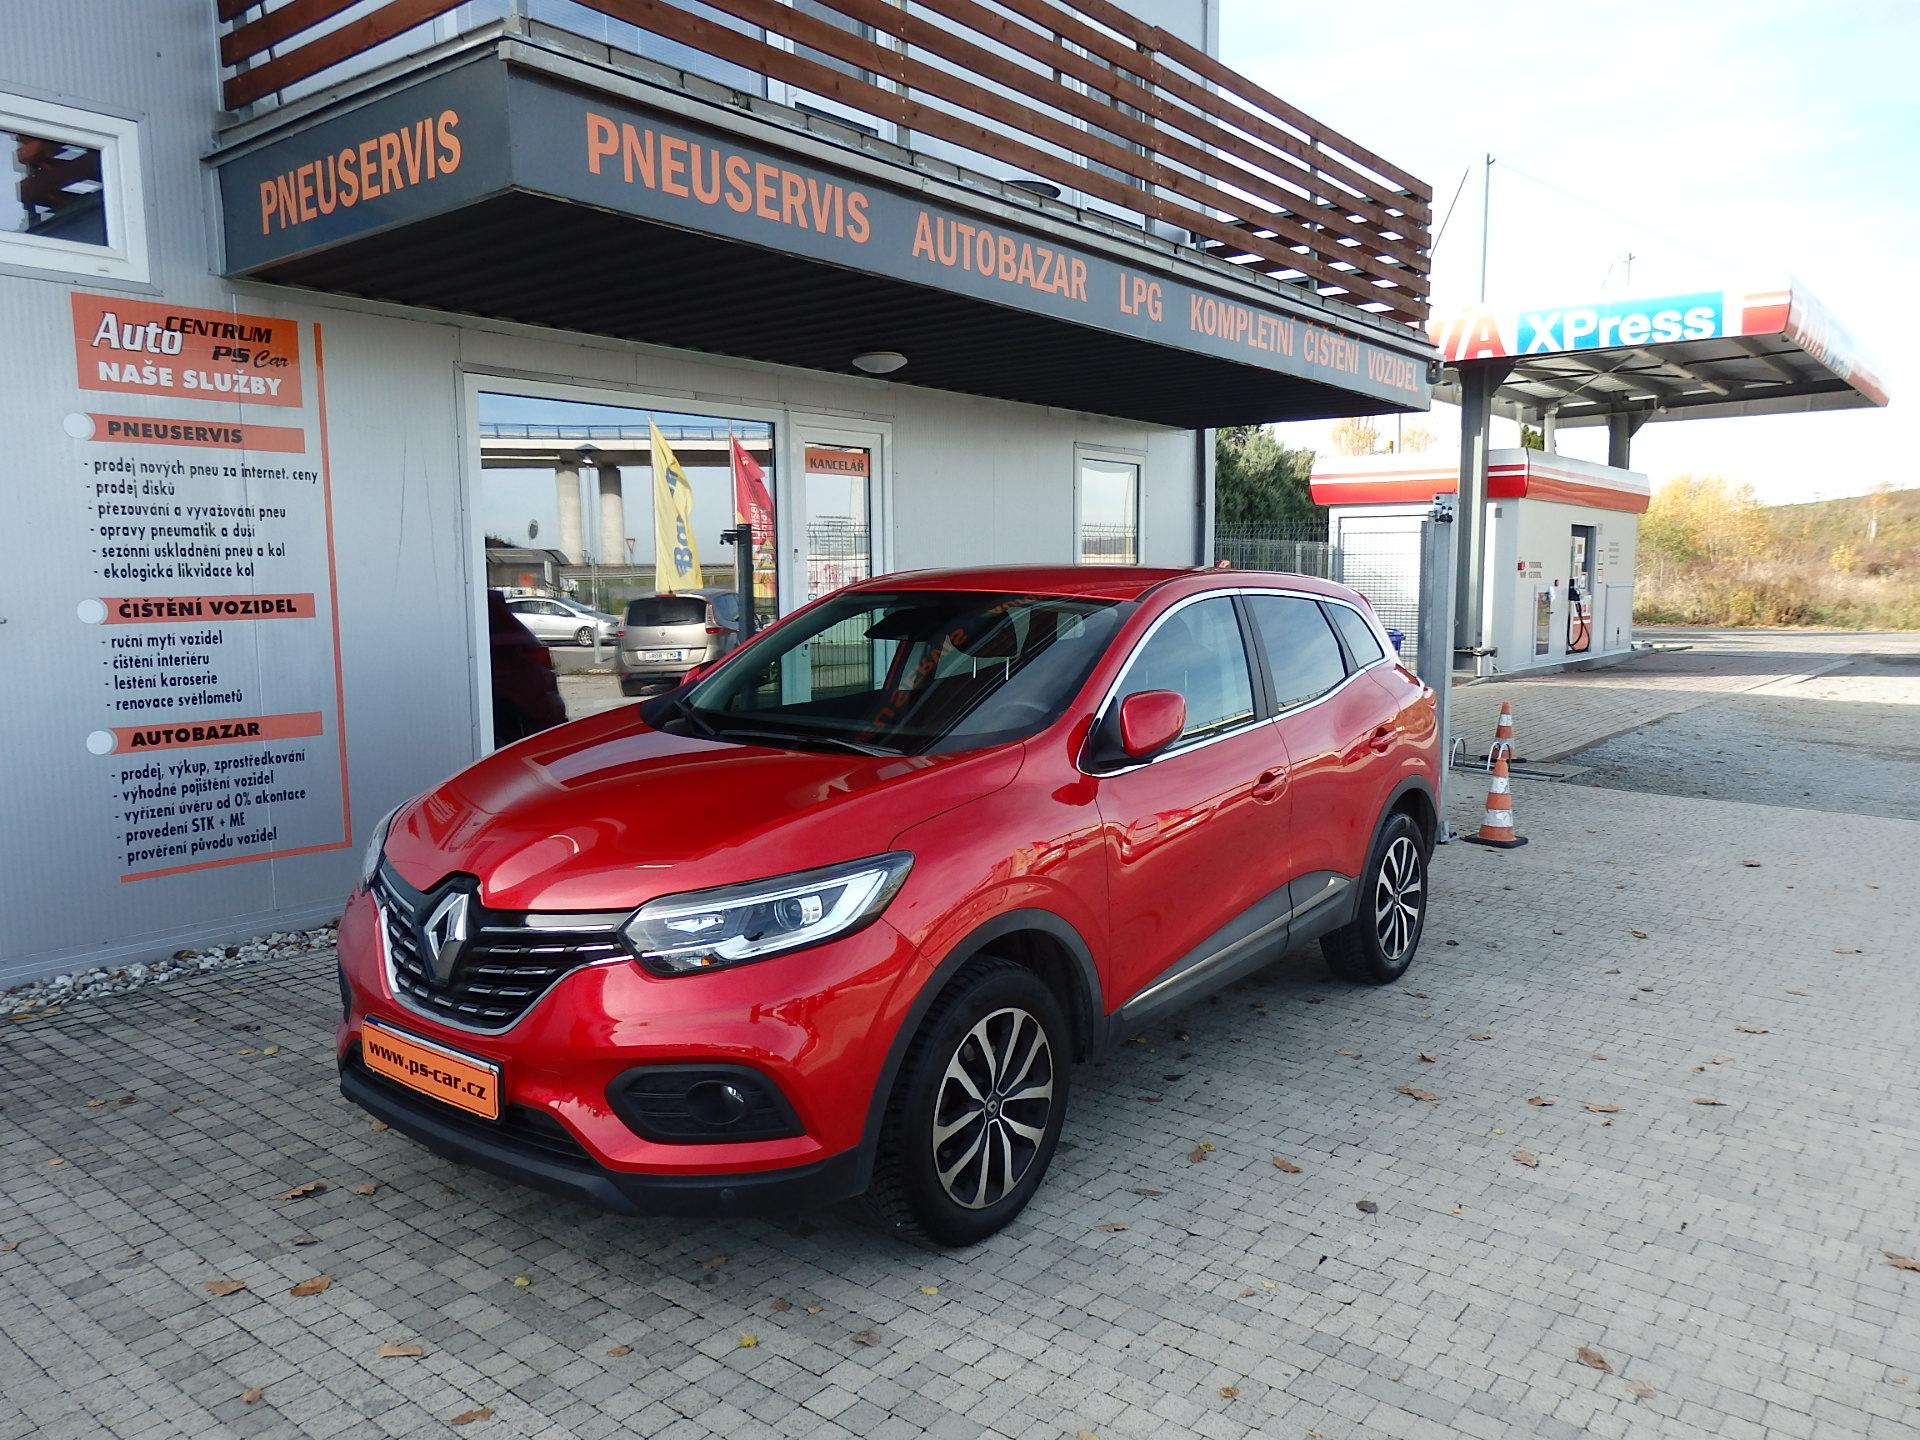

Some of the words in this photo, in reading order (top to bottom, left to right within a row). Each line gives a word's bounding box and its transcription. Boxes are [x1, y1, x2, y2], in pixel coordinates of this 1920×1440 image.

[260, 110, 462, 235] PNEUSERVIS
[585, 111, 871, 245] PNEUSERVIS
[912, 210, 1088, 303] AUTOBAZAR
[1119, 272, 1163, 323] LPG
[1190, 292, 1295, 358] KOMPLETNÍ
[1302, 319, 1359, 376] ČIŠTĚNÍ
[1367, 349, 1419, 394] VOZIDEL
[91, 312, 183, 356] Auto
[165, 316, 272, 344] CENTRUM
[212, 345, 250, 364] PS
[253, 350, 290, 368] Car
[98, 359, 173, 388] NAŠE
[183, 369, 282, 396] SLUŽBY
[108, 420, 243, 444] PNEUSERVIS
[94, 457, 136, 476] prodej
[140, 460, 185, 478] nových
[190, 464, 218, 479] pneu
[223, 465, 237, 477] za
[292, 470, 318, 484] ceny
[809, 456, 865, 473] KANCELÁŘ
[96, 480, 138, 498] prodej
[98, 502, 170, 518] přezouvání
[174, 505, 182, 516] a
[186, 505, 256, 521] vyvažování
[259, 506, 286, 522] pneu
[100, 525, 146, 540] opravy
[151, 523, 216, 540] pneumatik
[221, 526, 228, 537] a
[225, 546, 253, 560] pneu
[257, 546, 264, 556] a
[268, 542, 286, 556] kol
[104, 562, 174, 582] ekologická
[178, 562, 232, 578] likvidace
[236, 562, 255, 578] kol
[119, 598, 203, 618] ČIŠTĚNÍ
[209, 599, 296, 615] VOZIDEL
[111, 634, 143, 649] ruční
[147, 632, 176, 650] mytí
[180, 630, 223, 646] vozidel
[113, 654, 154, 670] čištění
[157, 652, 210, 667] interiéru
[114, 674, 157, 690] leštění
[160, 670, 218, 687] karoserie
[116, 696, 174, 711] renovace
[178, 689, 243, 706] světlometů
[131, 722, 260, 748] AUTOBAZAR
[214, 749, 306, 772] zprostředkování
[122, 784, 177, 804] výhodné
[234, 770, 274, 788] vozidel
[124, 804, 177, 825] vyřízení
[217, 798, 231, 810] od
[234, 792, 252, 806] 0%
[255, 788, 306, 804] akontace
[126, 820, 188, 846] provedení
[192, 817, 215, 832] STK
[229, 812, 246, 827] ME
[128, 840, 187, 866] prověření
[191, 832, 234, 851] původu
[237, 827, 278, 845] vozidel
[369, 1041, 487, 1100] www.ps-car.cz
